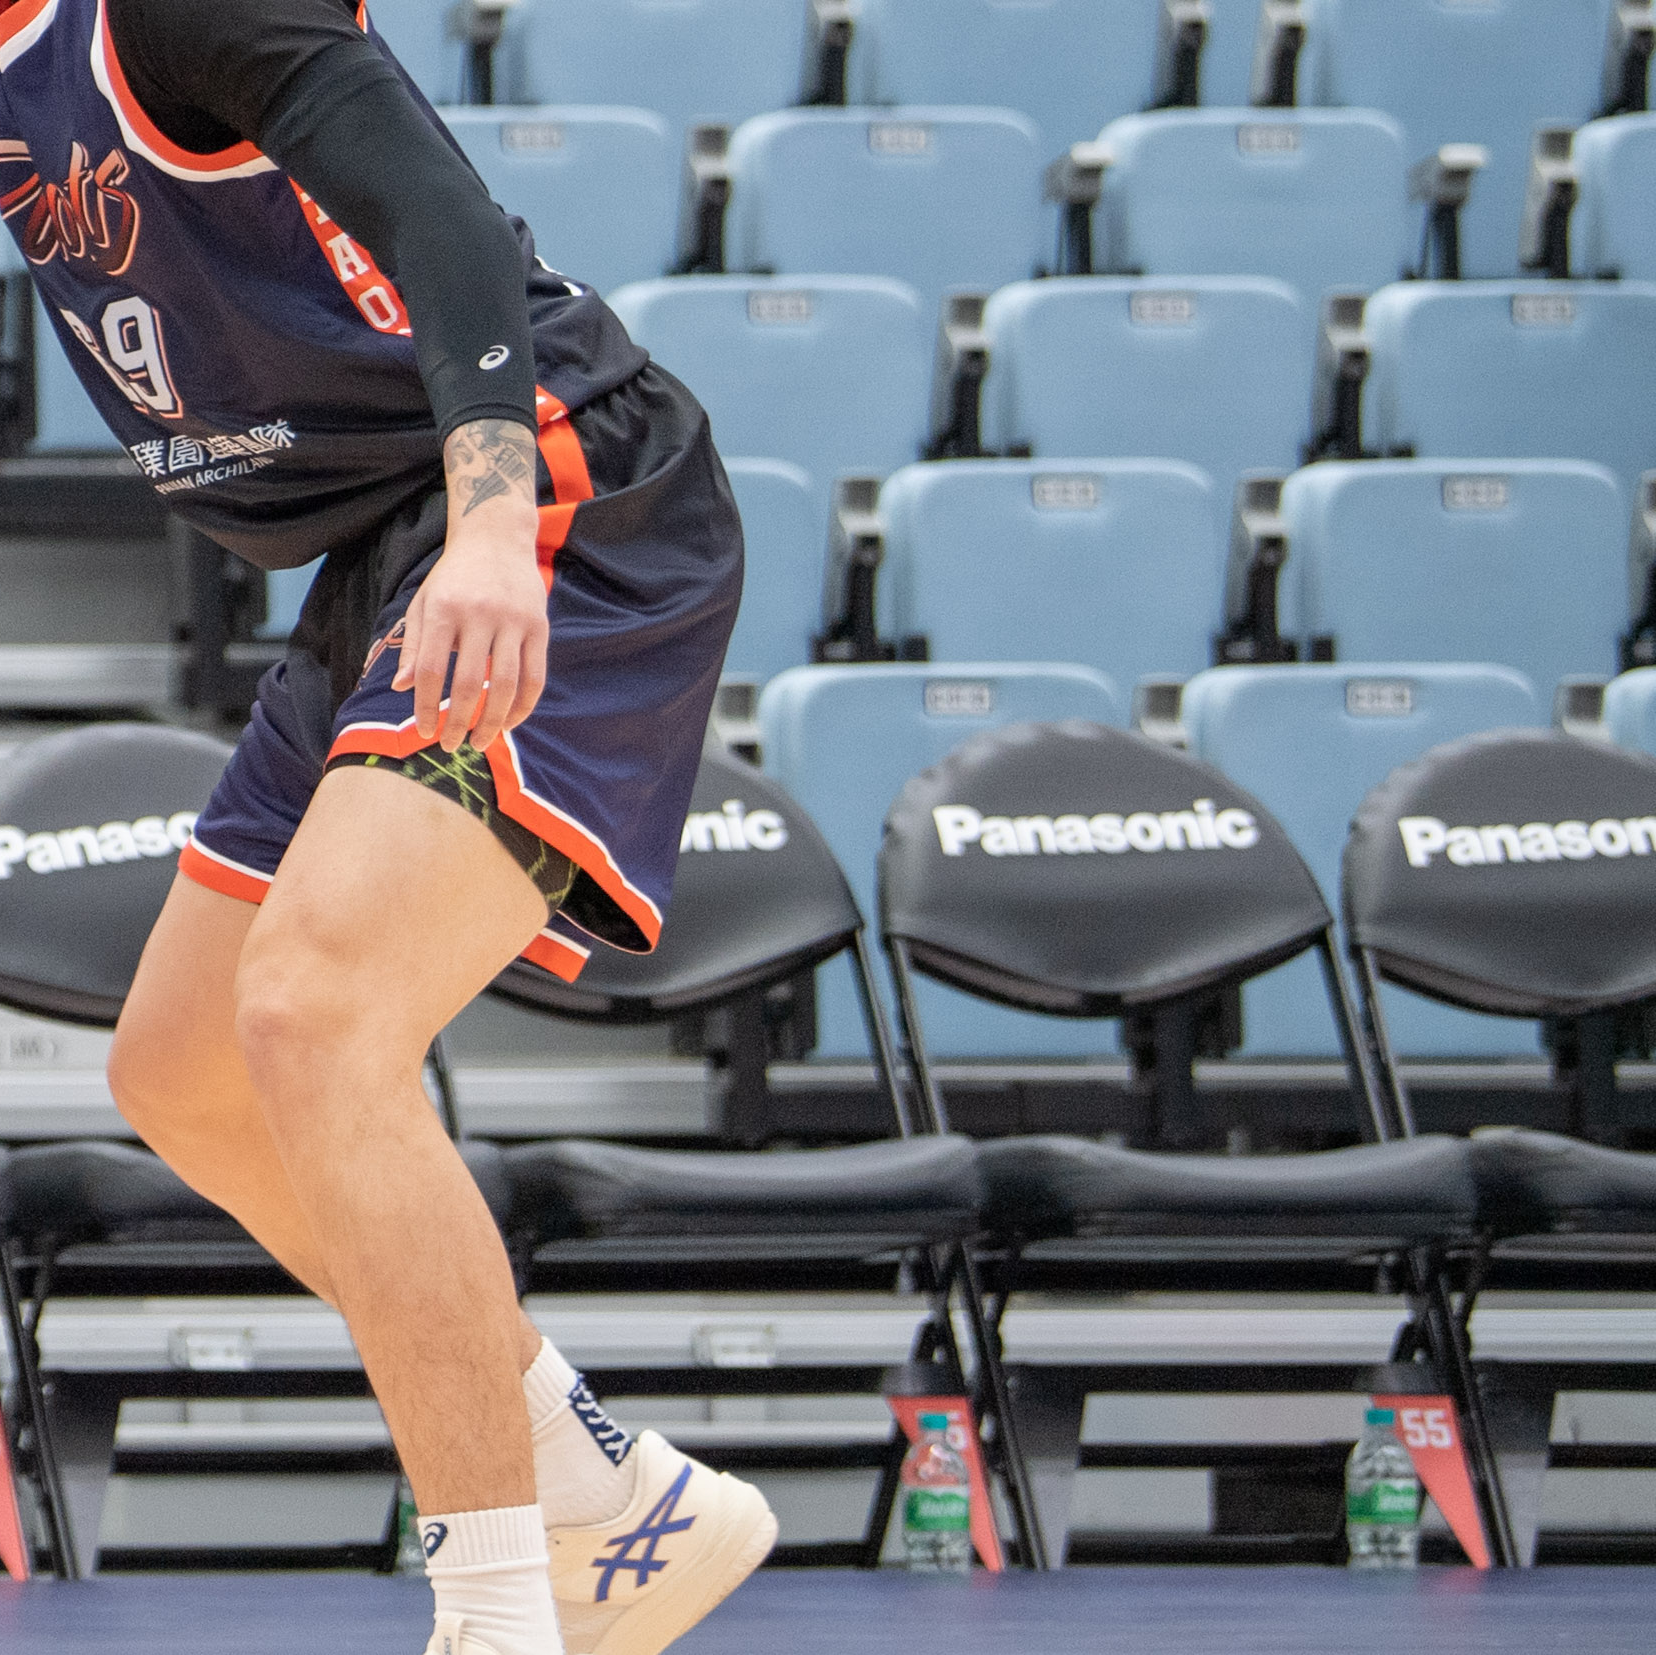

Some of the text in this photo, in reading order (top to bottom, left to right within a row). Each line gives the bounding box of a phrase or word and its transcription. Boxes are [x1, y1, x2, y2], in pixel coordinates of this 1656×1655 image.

[931, 798, 1260, 857] Panasonic
[1398, 816, 1656, 867] Panason
[1400, 1408, 1451, 1449] 55
